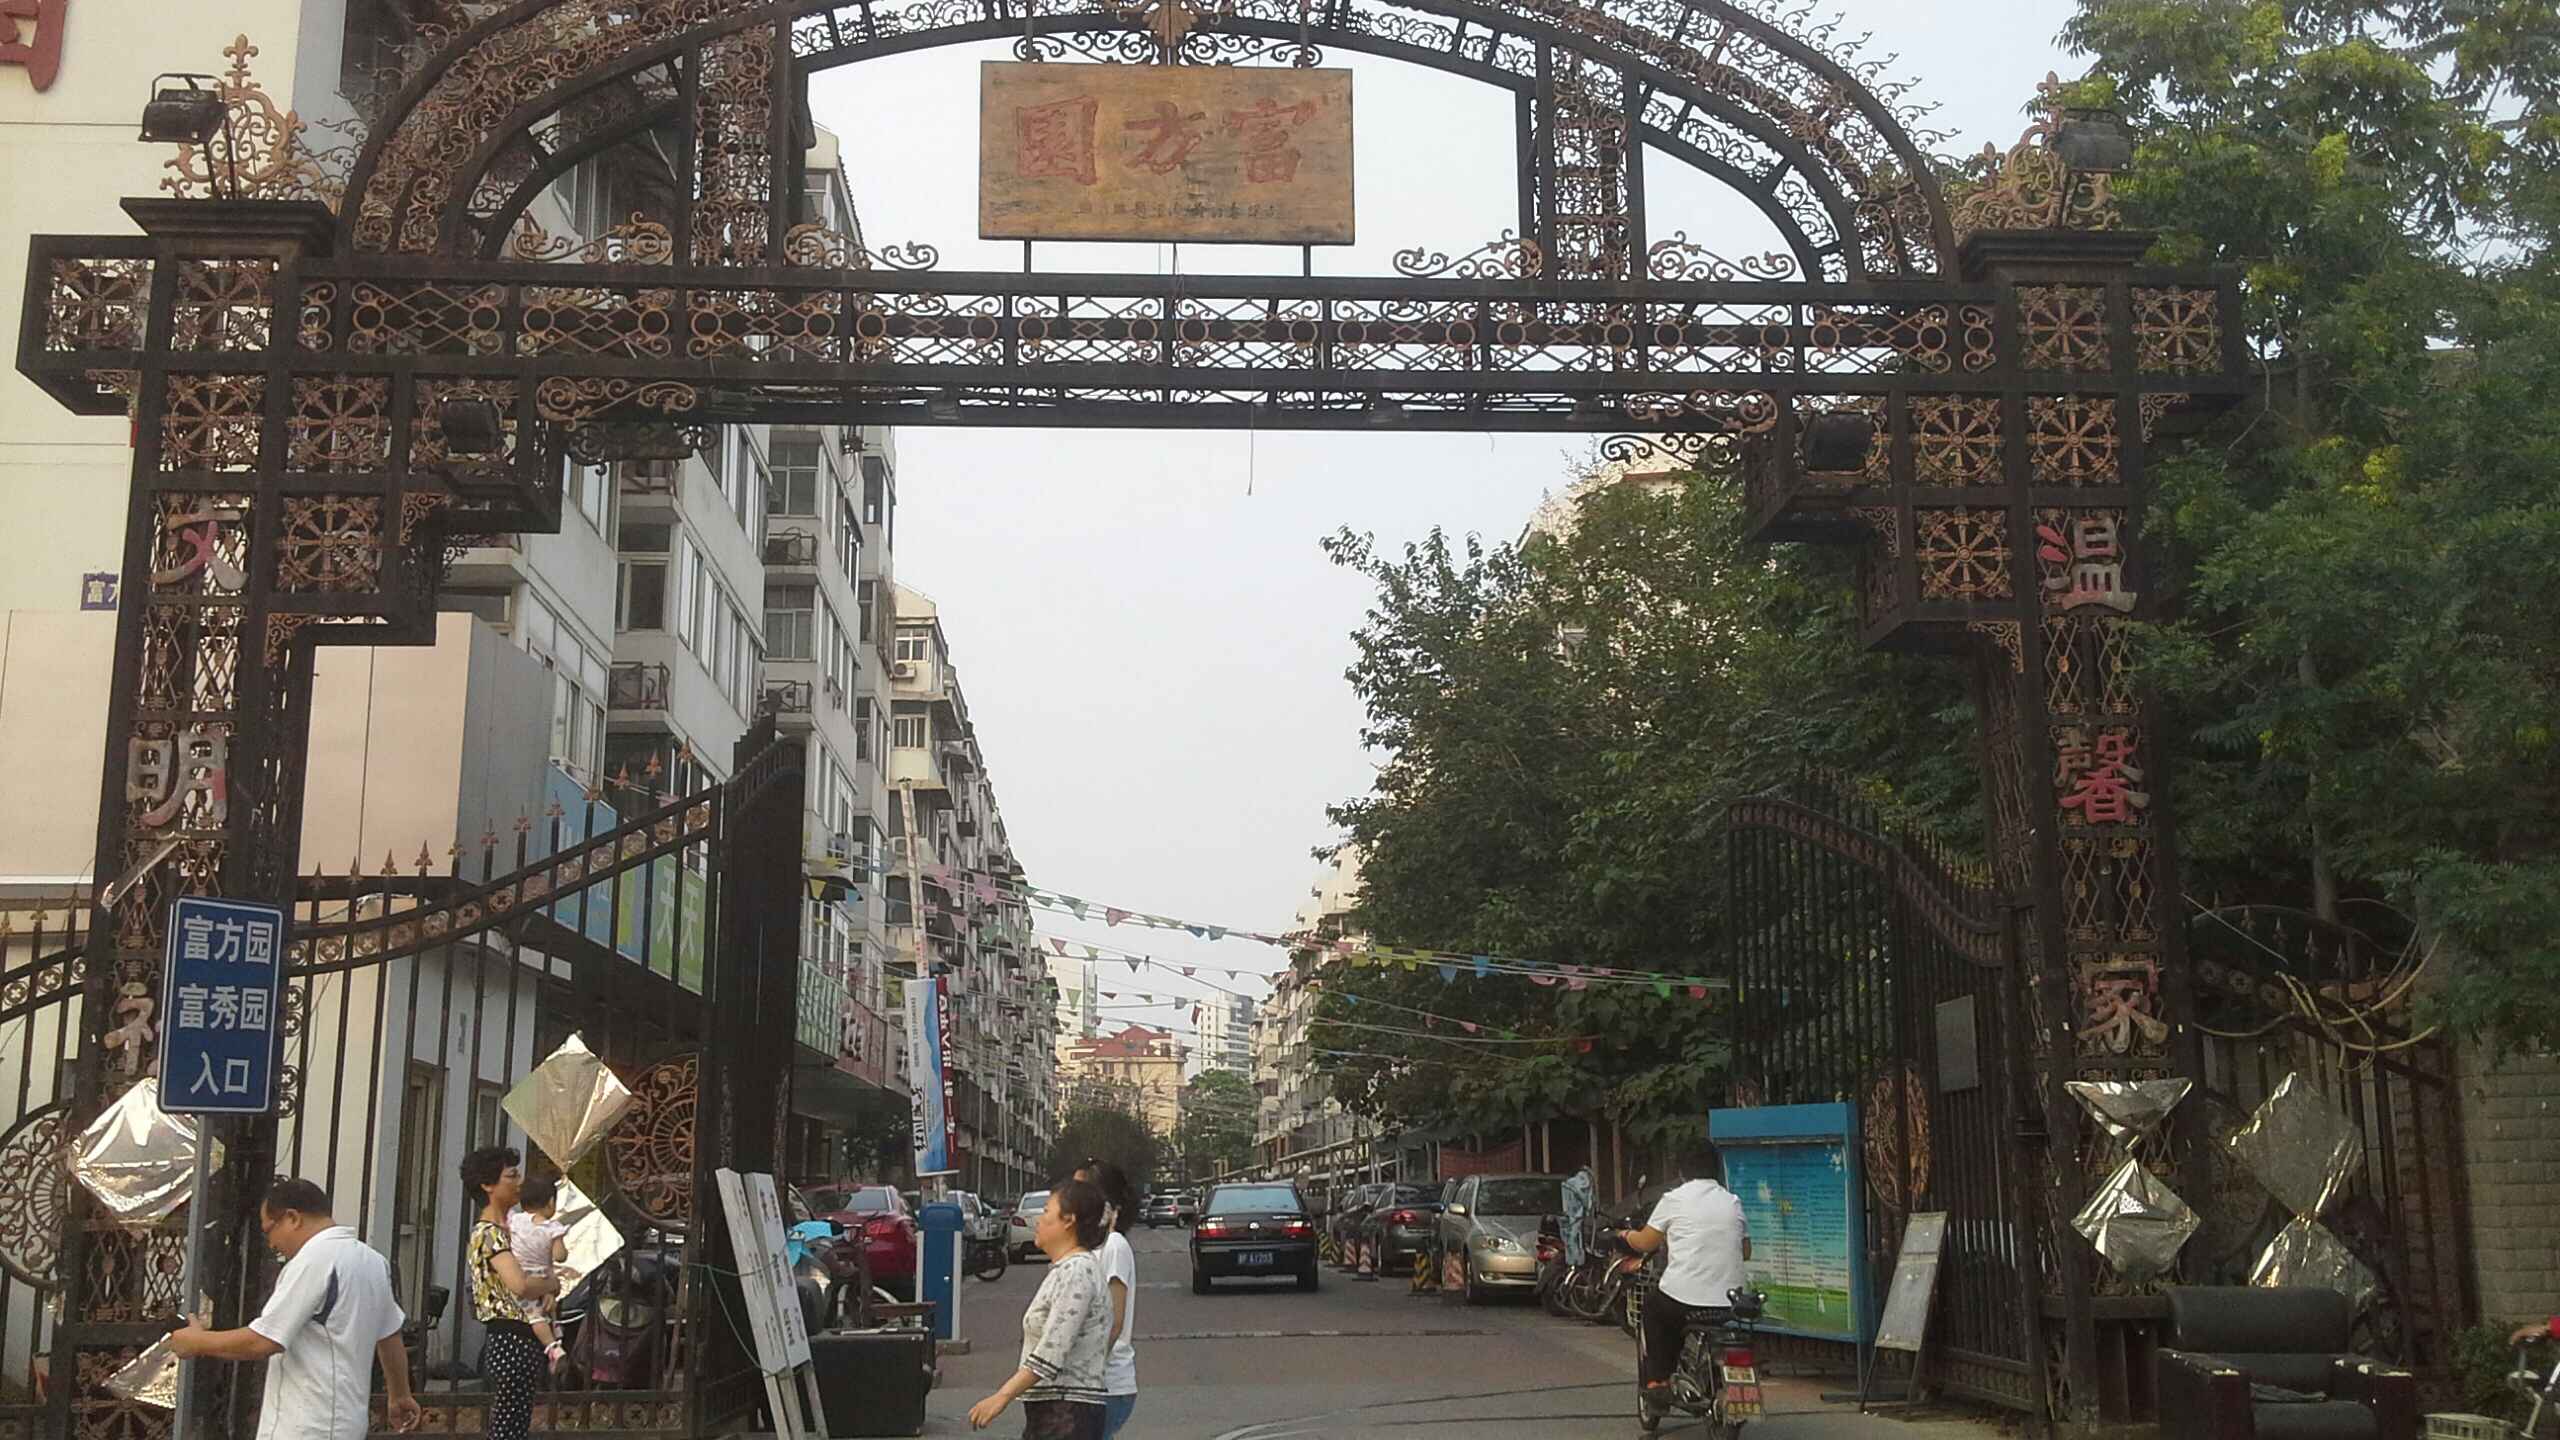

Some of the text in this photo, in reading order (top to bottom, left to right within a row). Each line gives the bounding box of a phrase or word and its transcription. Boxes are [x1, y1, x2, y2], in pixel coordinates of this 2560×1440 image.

[183, 914, 274, 965] 富方园
[177, 982, 269, 1032] 富秀园
[189, 1050, 250, 1096] 入口
